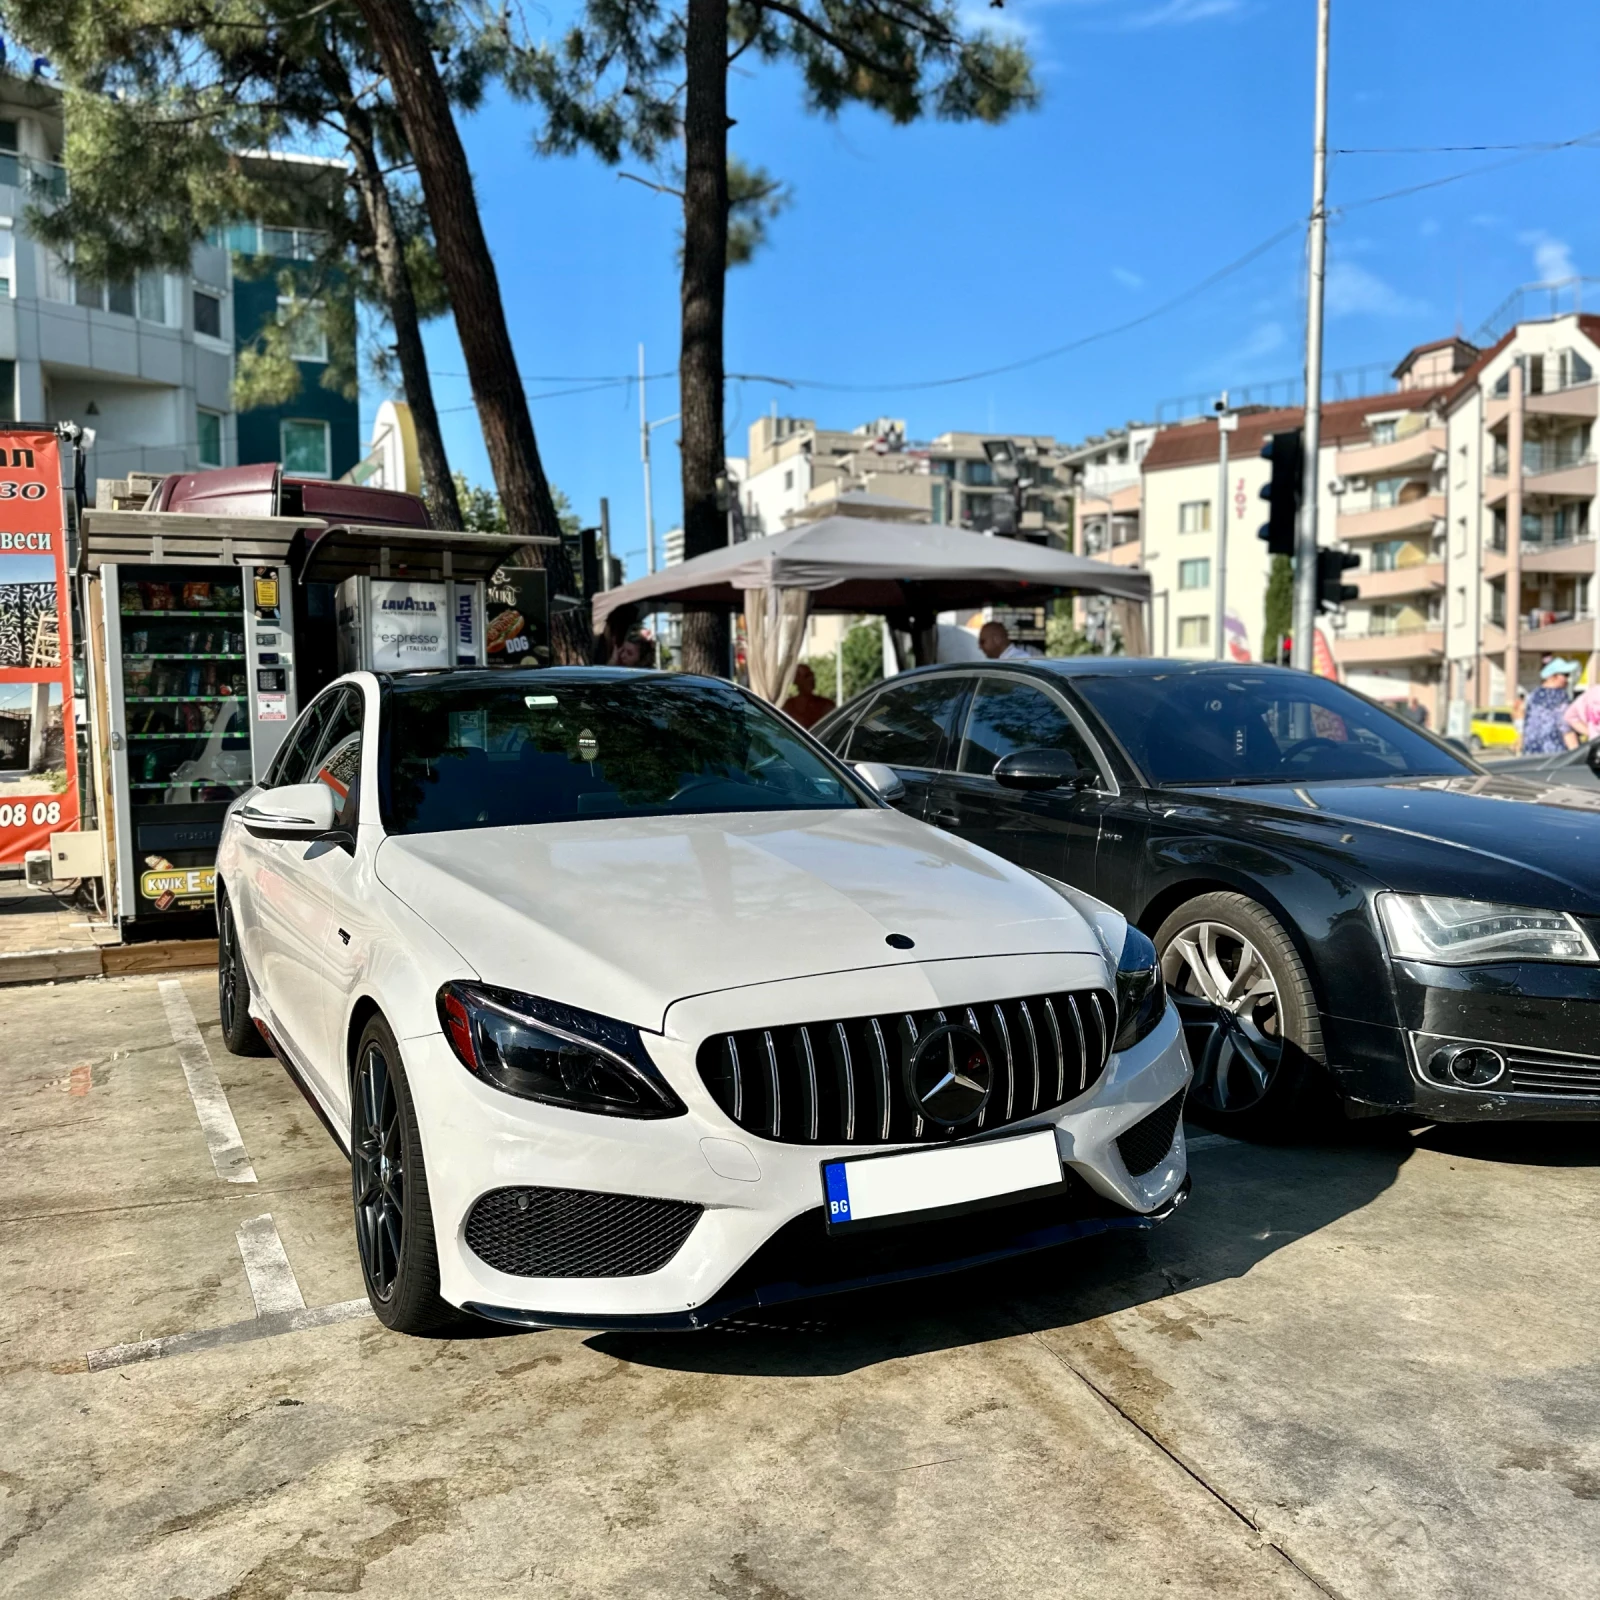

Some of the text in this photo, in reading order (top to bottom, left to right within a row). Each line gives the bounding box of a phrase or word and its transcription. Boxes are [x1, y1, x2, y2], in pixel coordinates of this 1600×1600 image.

[381, 596, 437, 612] LAVAZZA
[455, 594, 473, 644] LAVAZZA
[505, 636, 529, 653] DOG
[0, 801, 61, 827] 08 08
[831, 1200, 848, 1214] BG
